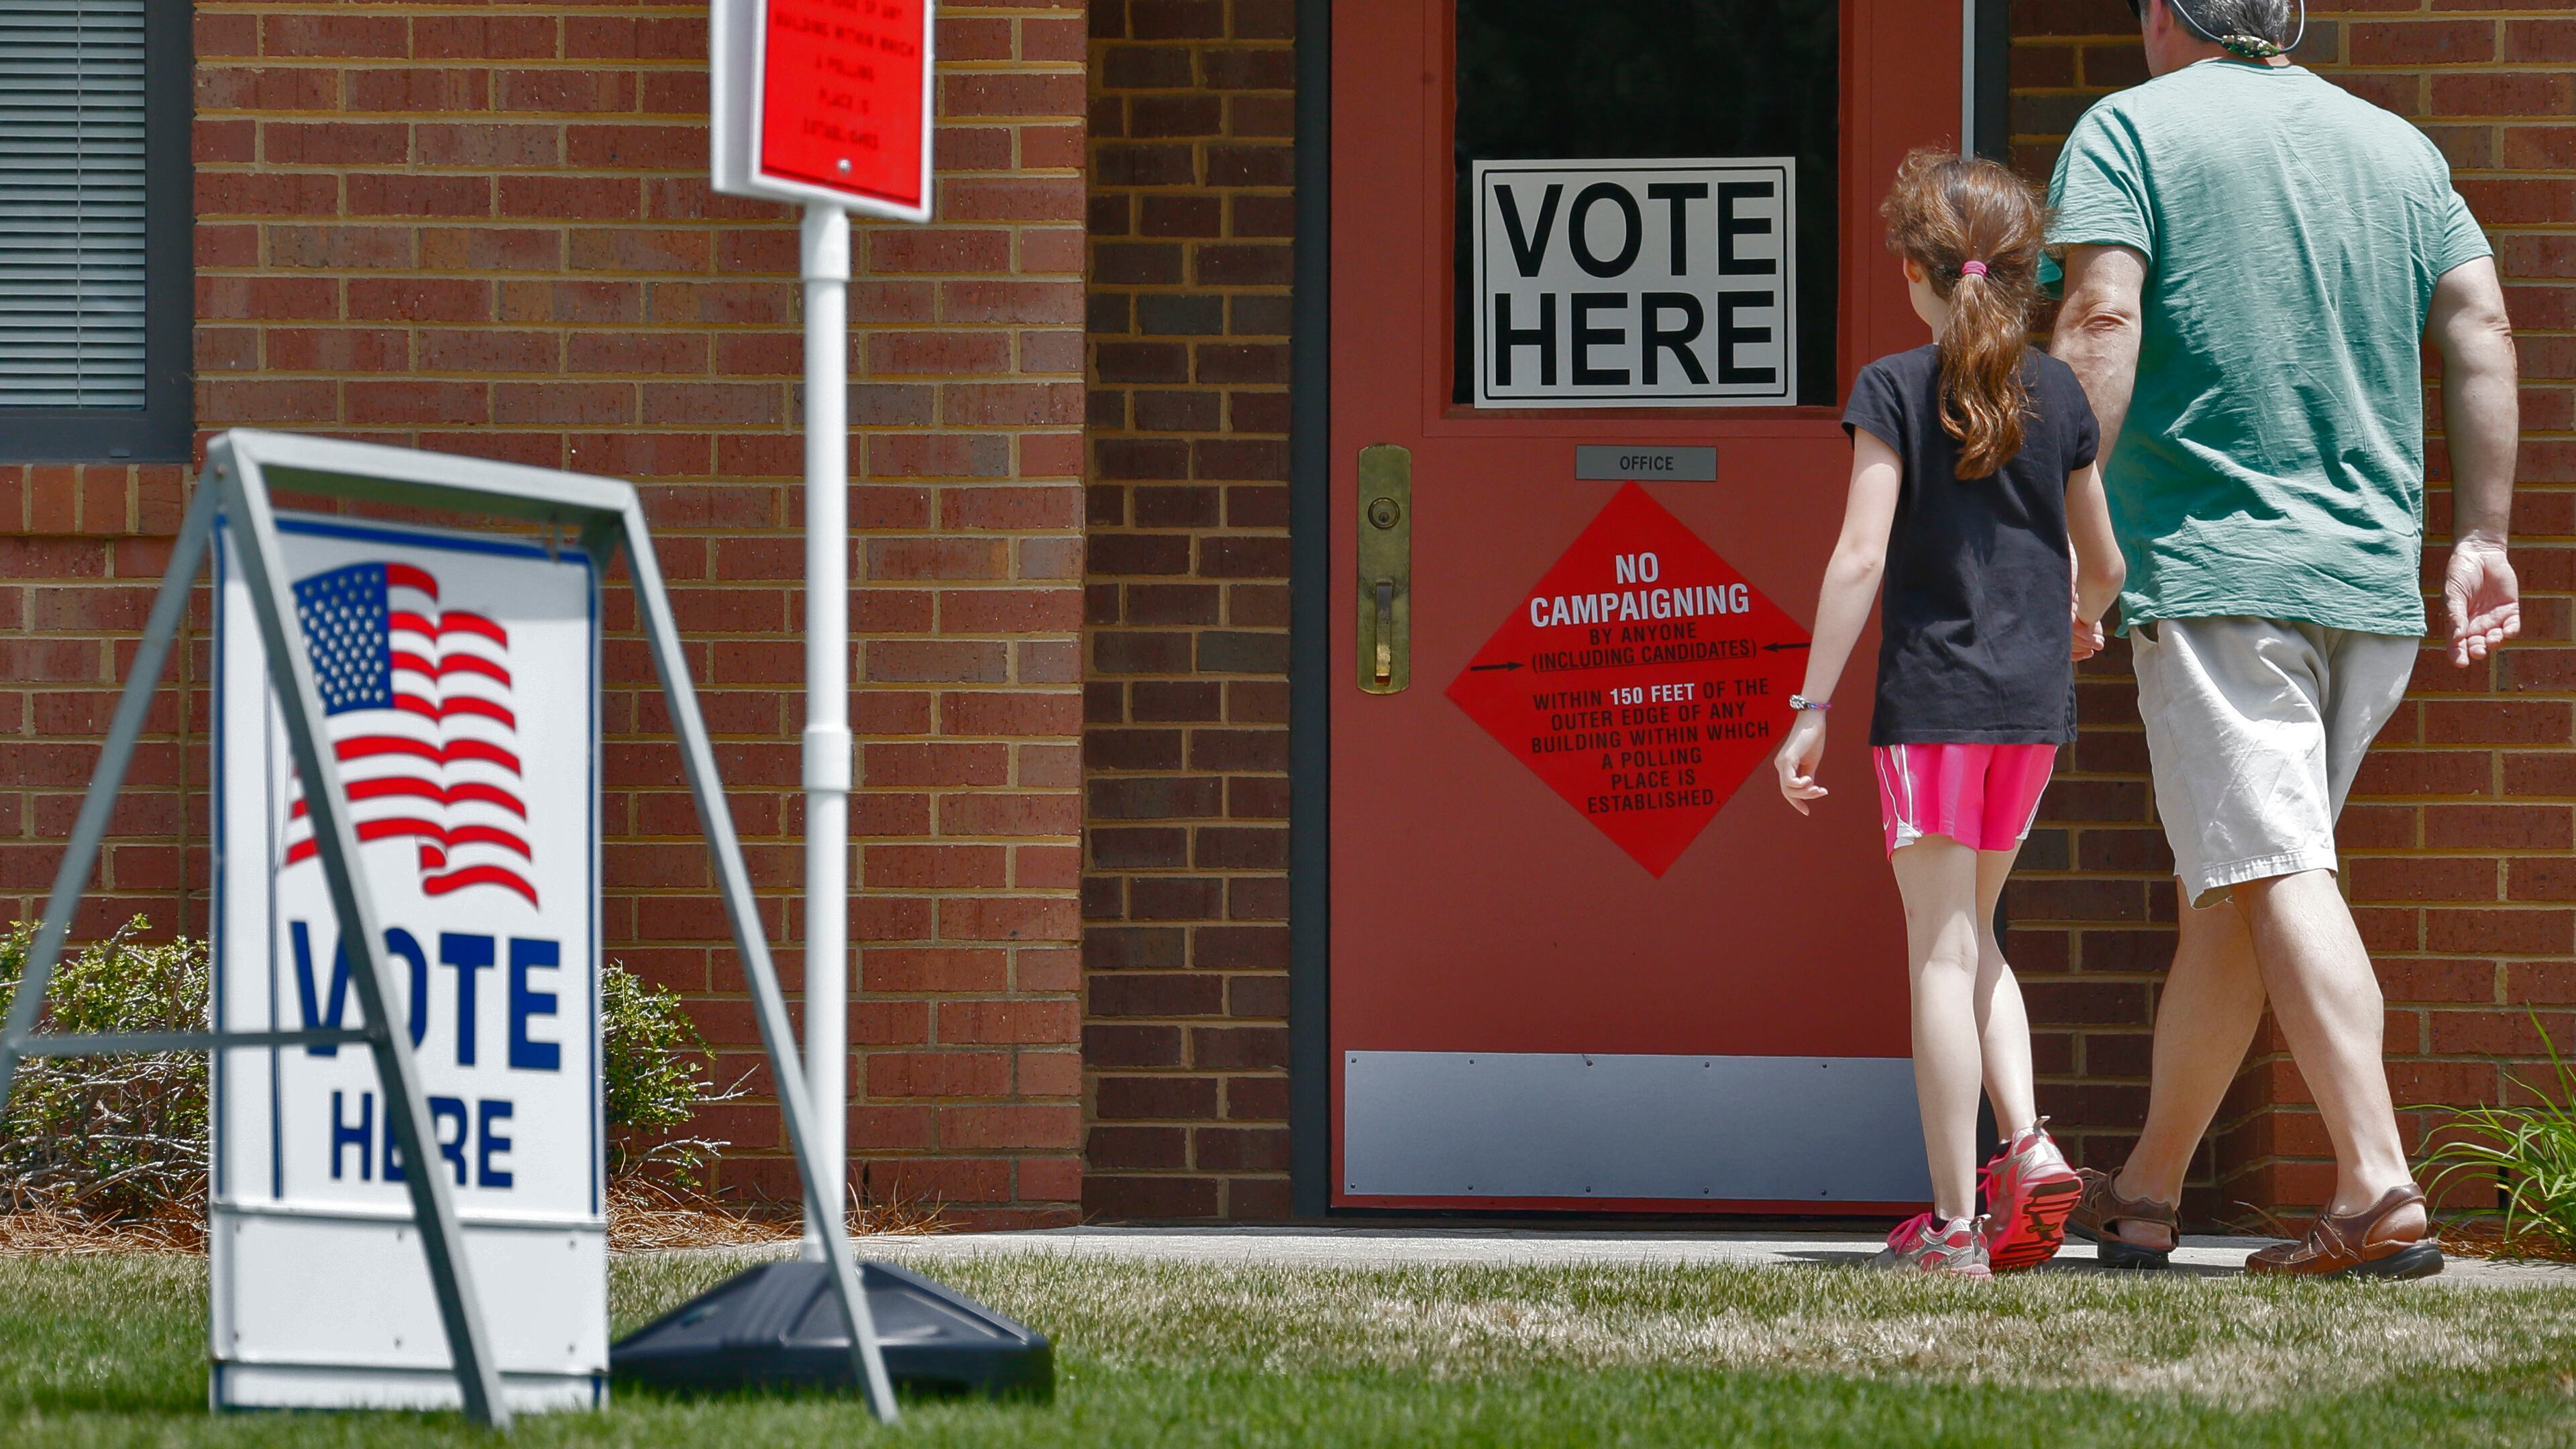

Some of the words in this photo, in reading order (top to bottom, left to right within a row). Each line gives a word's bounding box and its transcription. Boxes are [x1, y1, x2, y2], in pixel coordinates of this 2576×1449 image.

[1493, 180, 1777, 278] VOTE
[1494, 290, 1777, 386] HERE
[1619, 455, 1674, 472] OFFICE
[1615, 552, 1659, 585] NO
[1529, 582, 1750, 628] CAMPAIGNING
[1589, 628, 1613, 646] BY
[1621, 622, 1697, 643] ANYONE
[1531, 647, 1635, 673] (INCLUDING
[1641, 638, 1758, 663] CANDIDATES)
[1533, 690, 1603, 711] WITHIN
[1610, 686, 1644, 706] 150
[1650, 682, 1695, 703] FEET
[1703, 681, 1726, 699] OF
[1733, 678, 1770, 696] THE
[1551, 710, 1613, 731] OUTER
[1621, 706, 1670, 726] EDGE
[1678, 704, 1701, 722] OF
[1709, 700, 1747, 720] ANY
[1532, 731, 1621, 753] BUILDING
[1629, 726, 1699, 747] WITHIN
[1706, 720, 1770, 742] WHICH
[1601, 754, 1613, 770] A
[1621, 747, 1703, 769] POLLING
[1611, 771, 1670, 791] PLACE
[1678, 769, 1696, 786] IS
[1587, 788, 1721, 814] ESTABLISHED.
